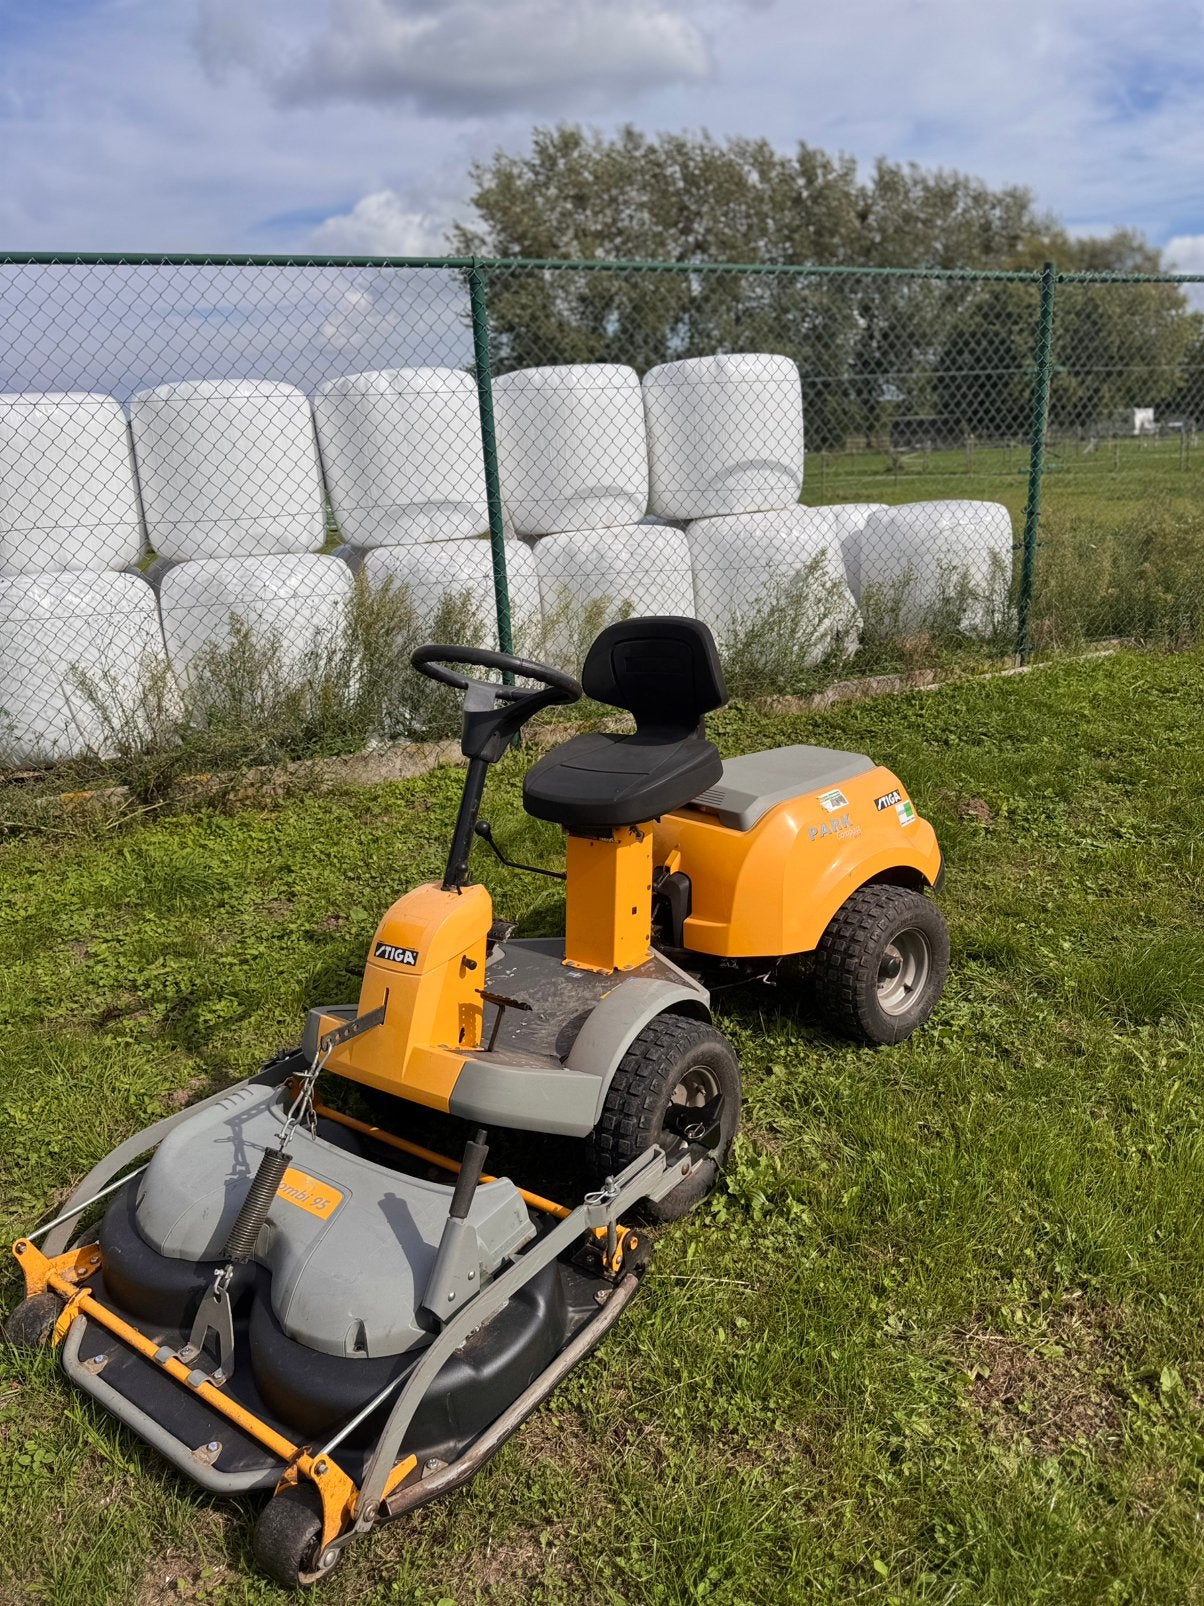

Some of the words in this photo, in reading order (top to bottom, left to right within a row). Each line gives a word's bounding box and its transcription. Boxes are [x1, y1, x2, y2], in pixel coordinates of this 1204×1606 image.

[878, 791, 901, 811] STIGA
[808, 814, 853, 841] PARK
[375, 945, 415, 965] STIGA
[278, 1182, 313, 1202] ombi
[310, 1196, 331, 1211] 95
